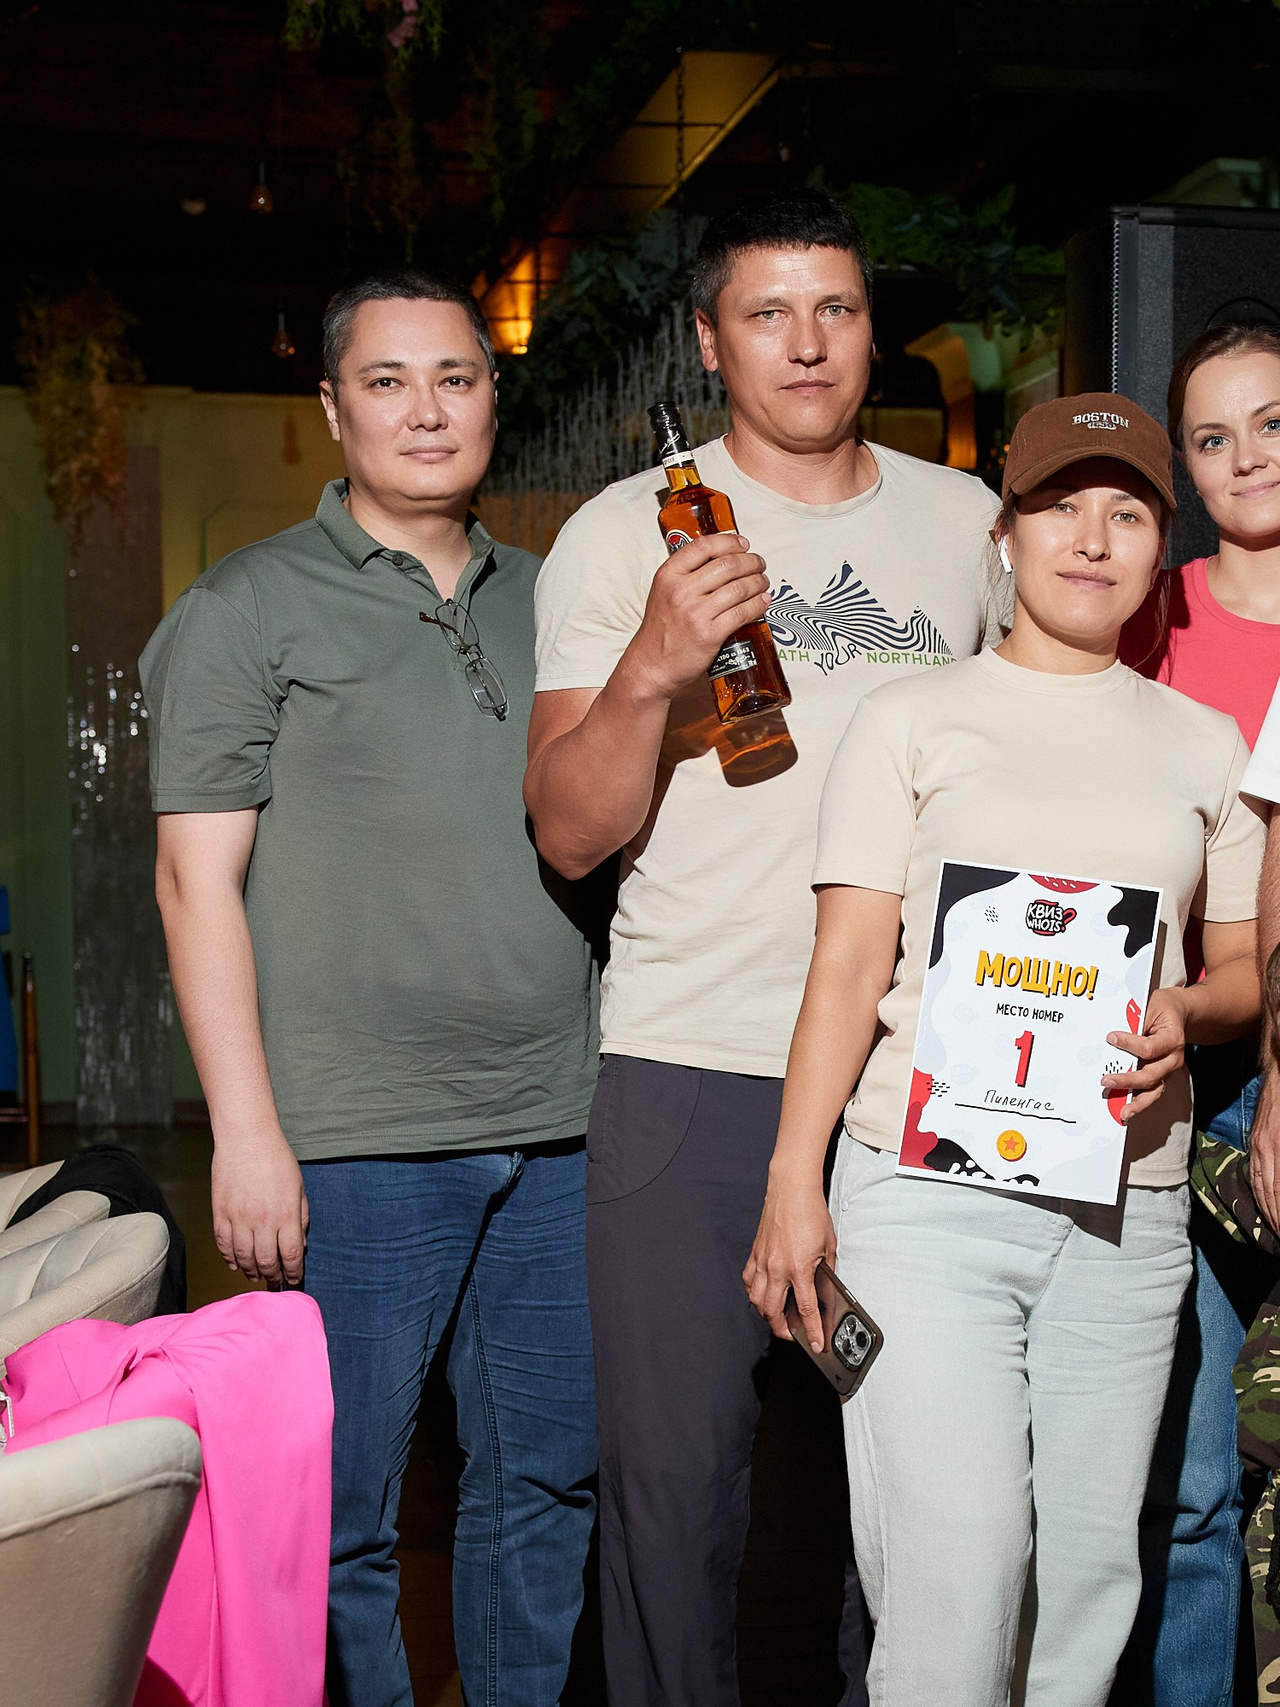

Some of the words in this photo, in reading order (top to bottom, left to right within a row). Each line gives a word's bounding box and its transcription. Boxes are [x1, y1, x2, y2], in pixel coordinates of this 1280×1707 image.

[1072, 411, 1130, 428] BOSTON
[778, 648, 810, 662] ATH
[814, 643, 862, 676] YOUR
[1027, 903, 1063, 920] КВИЗ
[996, 1003, 1029, 1018] МЕСТО
[1032, 1008, 1064, 1023] НОМЕР
[1014, 1030, 1035, 1088] 1
[984, 1089, 1054, 1111] Пиленгас
